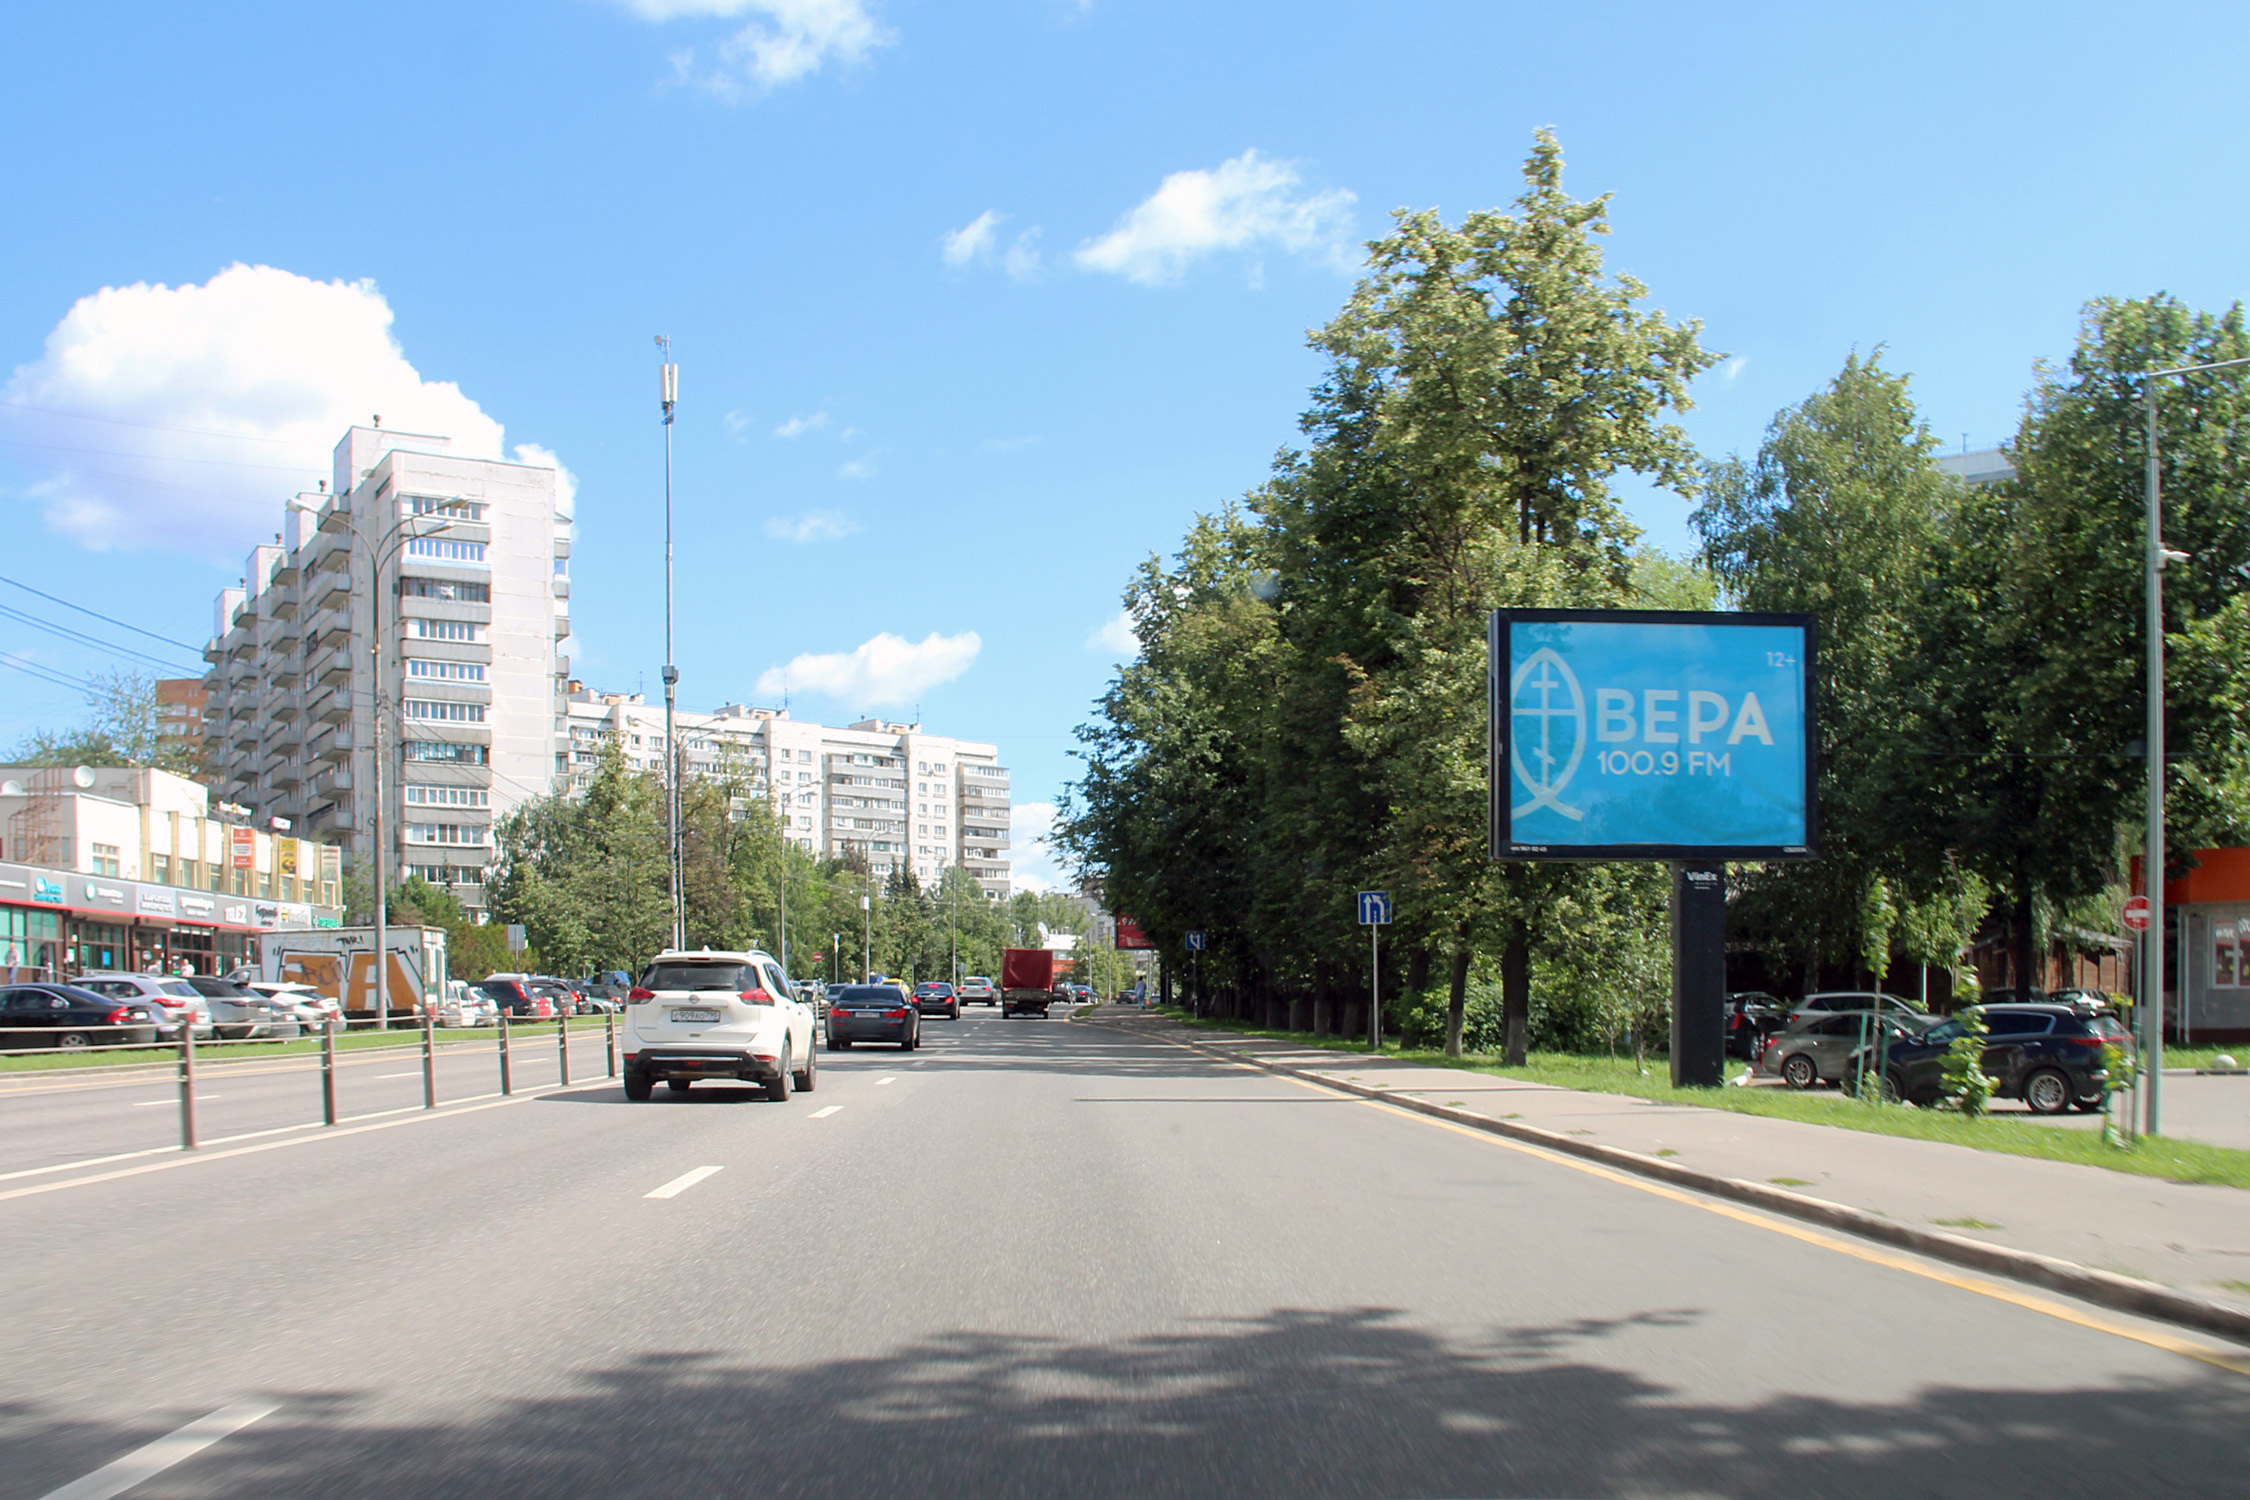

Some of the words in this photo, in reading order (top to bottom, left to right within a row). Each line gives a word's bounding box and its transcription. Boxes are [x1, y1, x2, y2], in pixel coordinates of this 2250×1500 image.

[1767, 652, 1796, 667] 12+
[1596, 688, 1774, 745] ВЕРА
[1597, 750, 1679, 775] 100.9
[1688, 752, 1730, 776] FM
